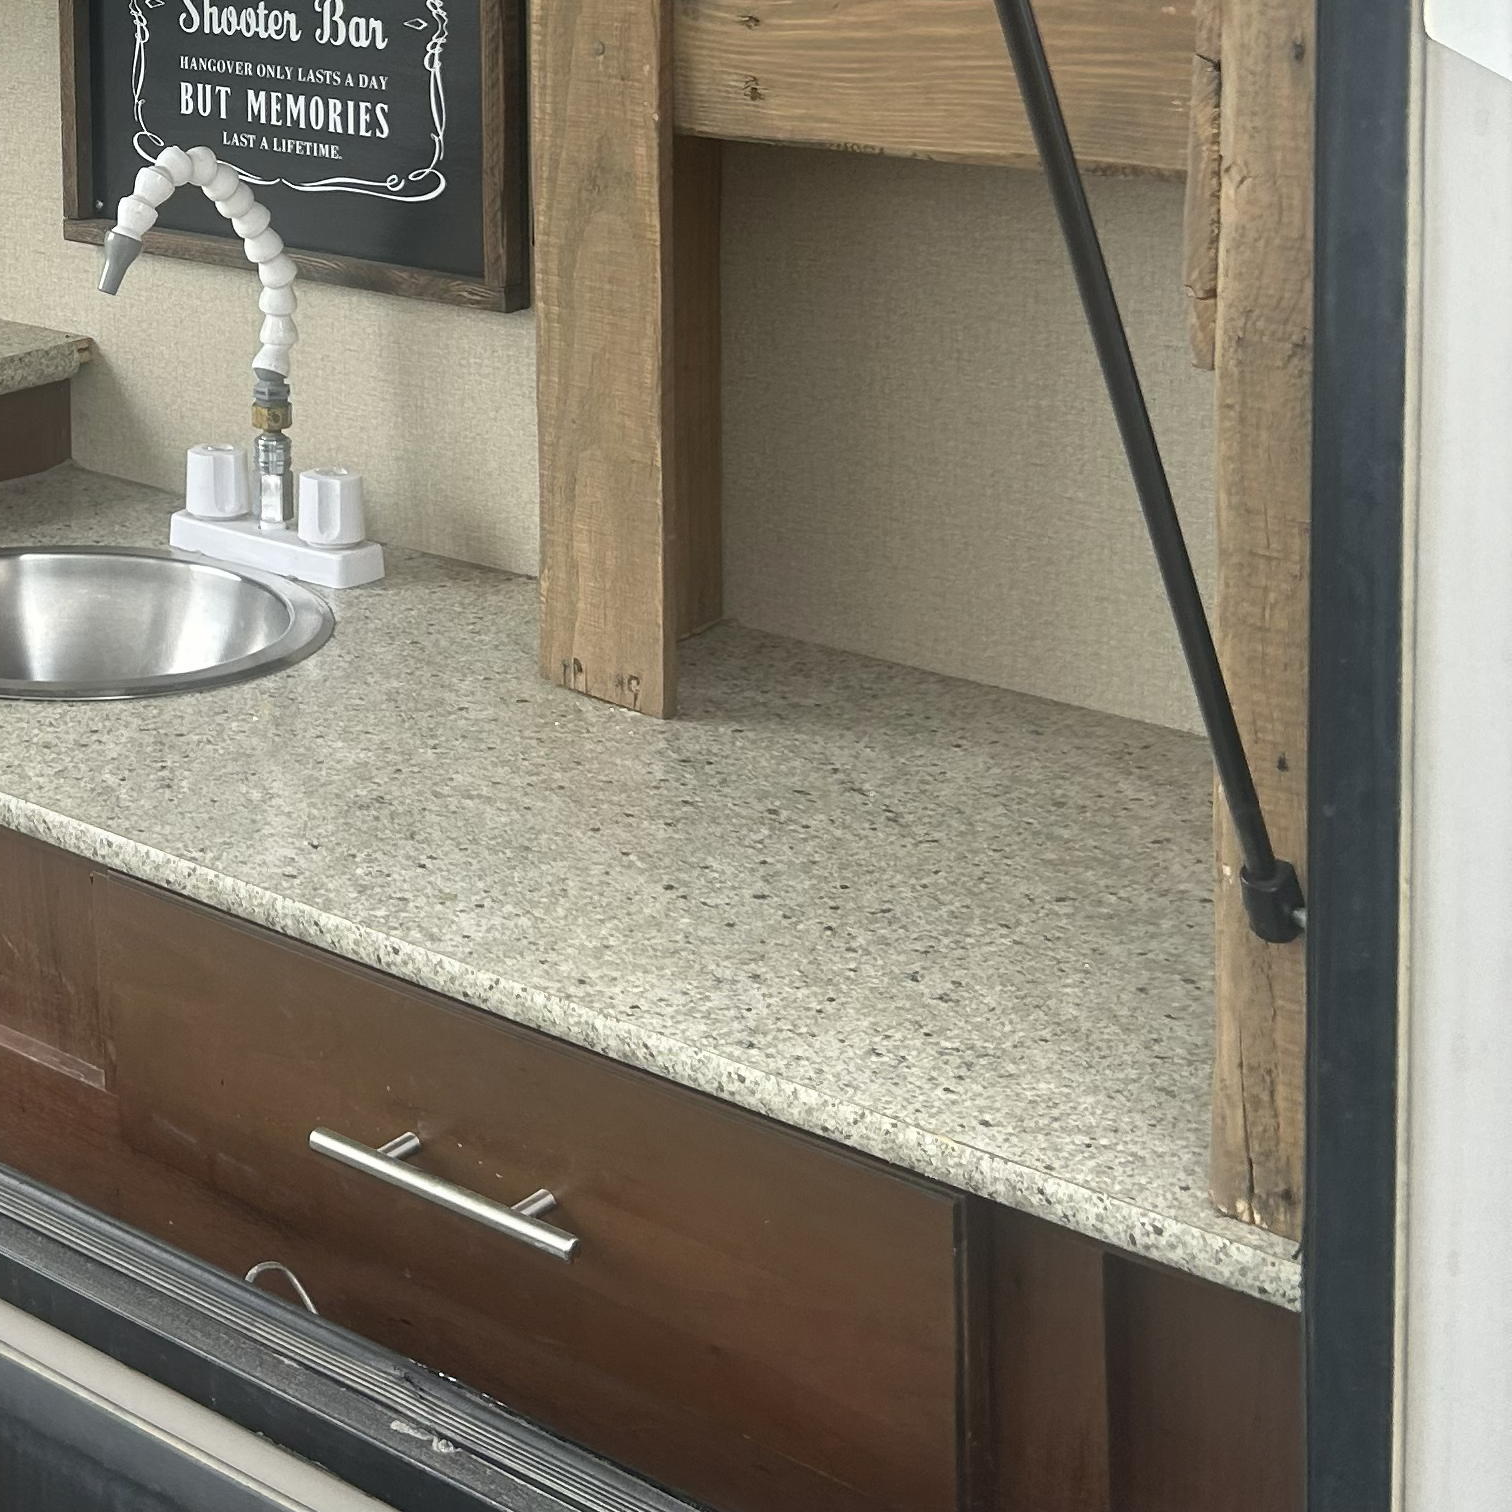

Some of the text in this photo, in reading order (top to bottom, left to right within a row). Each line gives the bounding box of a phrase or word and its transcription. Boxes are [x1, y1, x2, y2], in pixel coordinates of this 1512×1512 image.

[179, 55, 389, 91] HANGOVER ONLY LASTS A DAY
[179, 81, 390, 139] BUT MEMORIES
[222, 130, 344, 160] LAST A LIFETIME.
